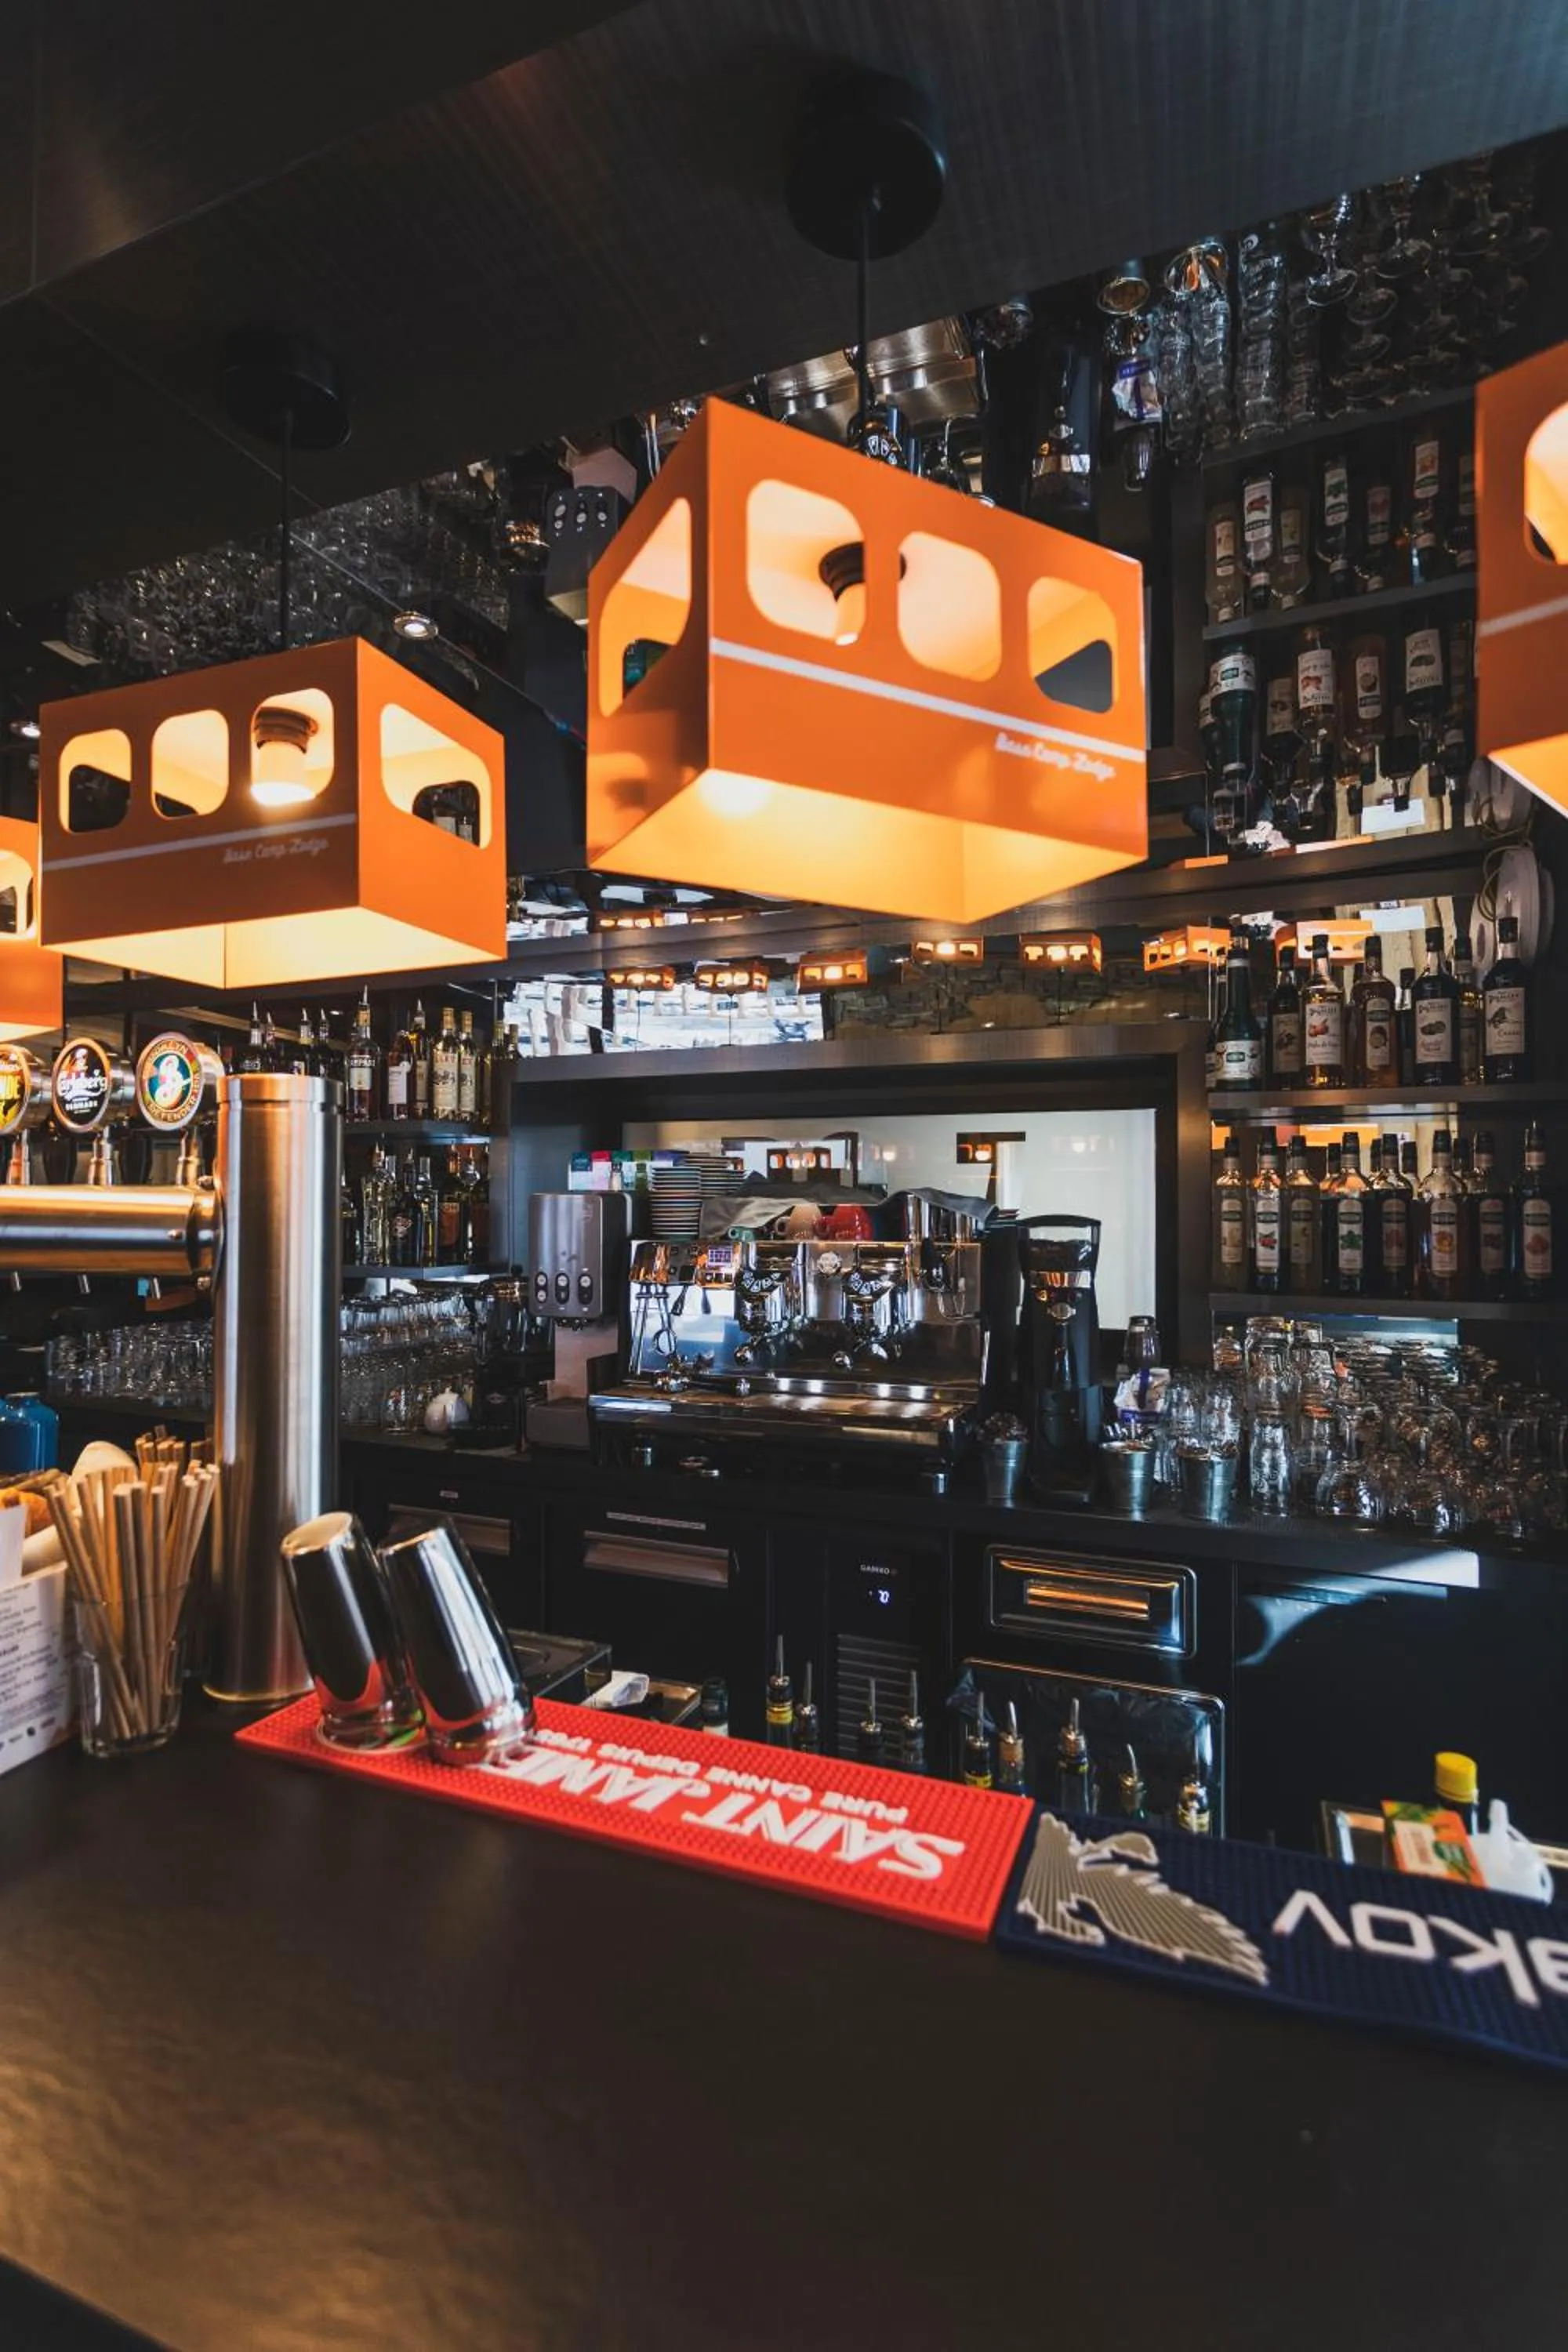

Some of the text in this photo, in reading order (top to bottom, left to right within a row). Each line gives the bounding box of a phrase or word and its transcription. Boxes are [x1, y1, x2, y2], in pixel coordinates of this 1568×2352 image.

[56, 1069, 108, 1098] Carlsberg
[597, 1742, 701, 1778] DEPUIS
[705, 1765, 814, 1802] CANNE
[474, 1741, 966, 1880] SAINT JAME
[821, 1789, 908, 1824] PURE
